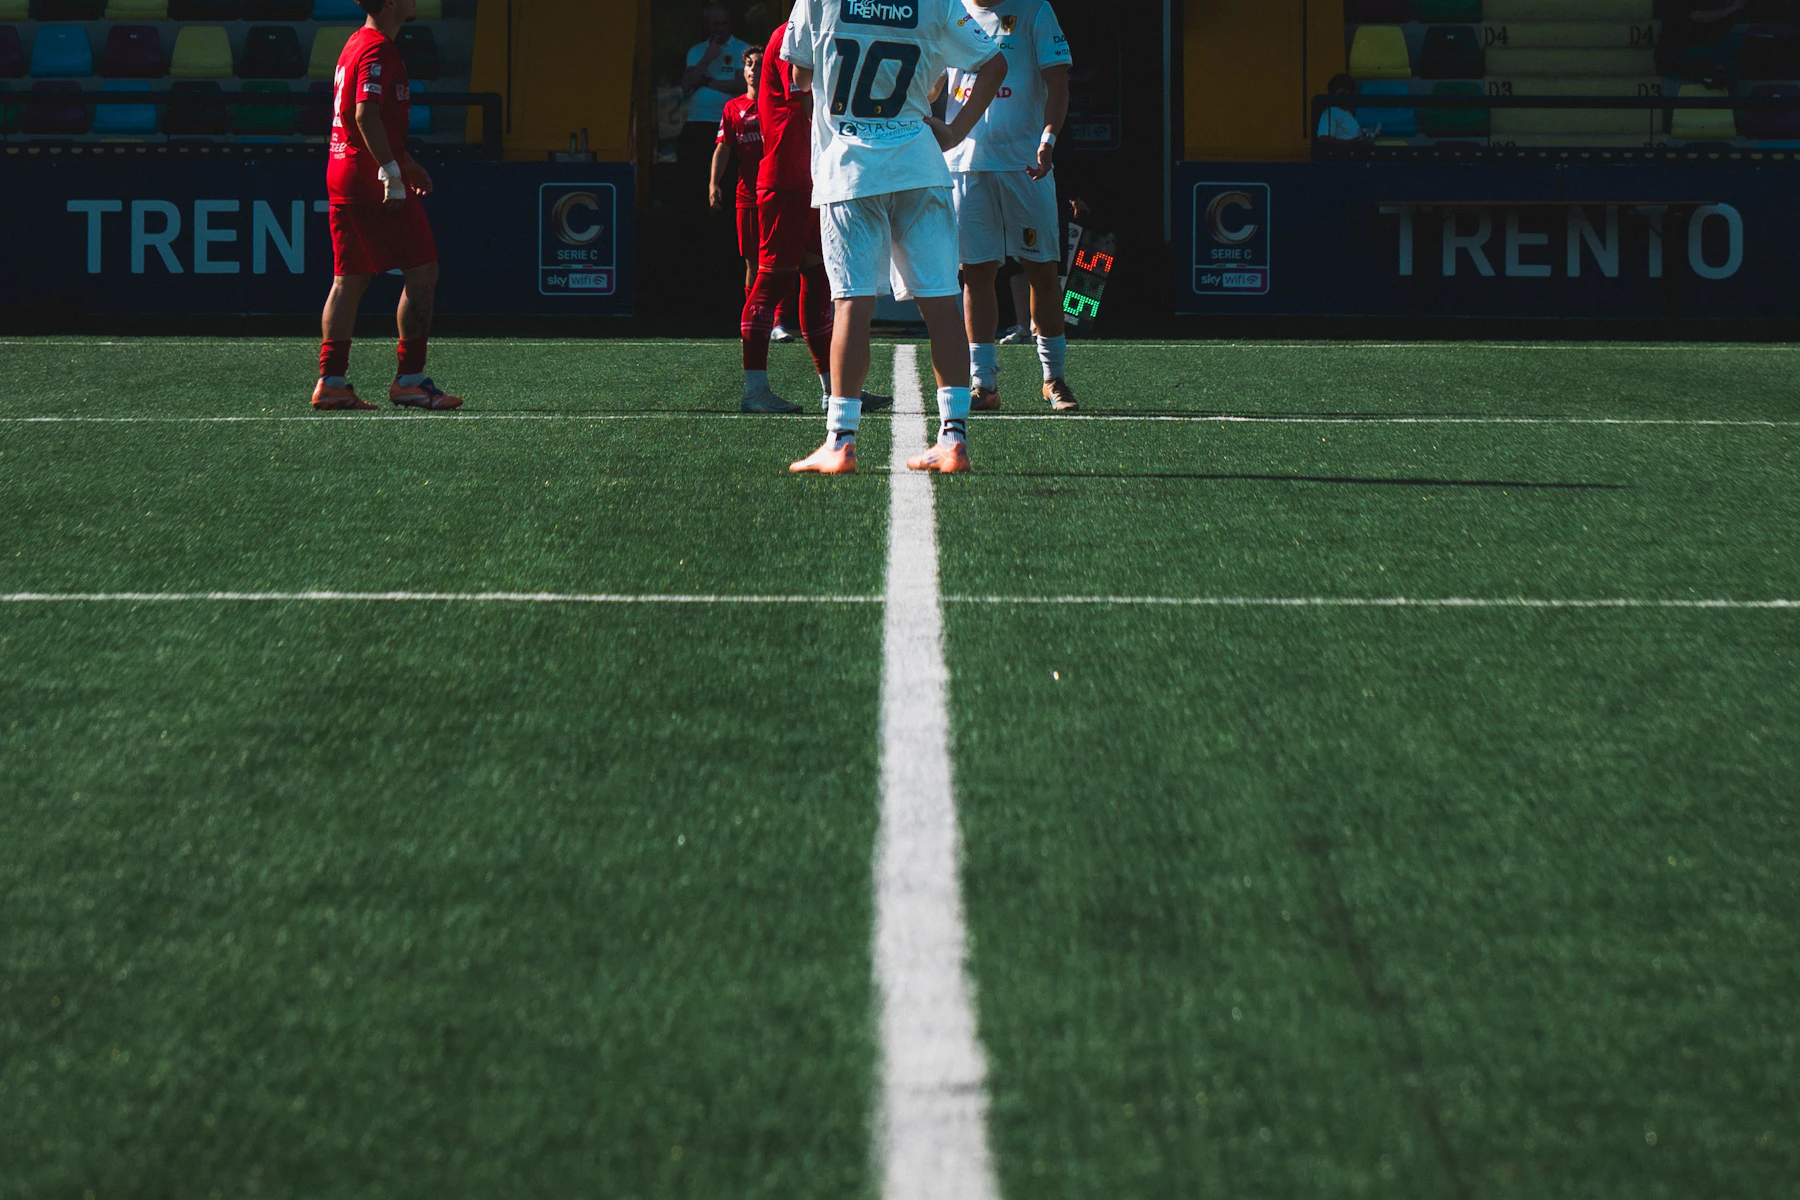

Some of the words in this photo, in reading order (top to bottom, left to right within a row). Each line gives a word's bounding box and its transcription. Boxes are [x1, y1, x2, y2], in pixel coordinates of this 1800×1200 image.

[1484, 26, 1509, 46] D4
[830, 37, 922, 118] 10
[67, 200, 330, 274] TREN
[1378, 202, 1744, 280] TRENTO
[557, 249, 588, 260] SERIE
[590, 249, 598, 260] C
[1211, 248, 1242, 259] SERIE
[1244, 248, 1252, 259] C
[547, 275, 568, 287] sky
[570, 274, 592, 285] wifi
[1201, 273, 1222, 286] sky
[1224, 273, 1246, 284] wifi
